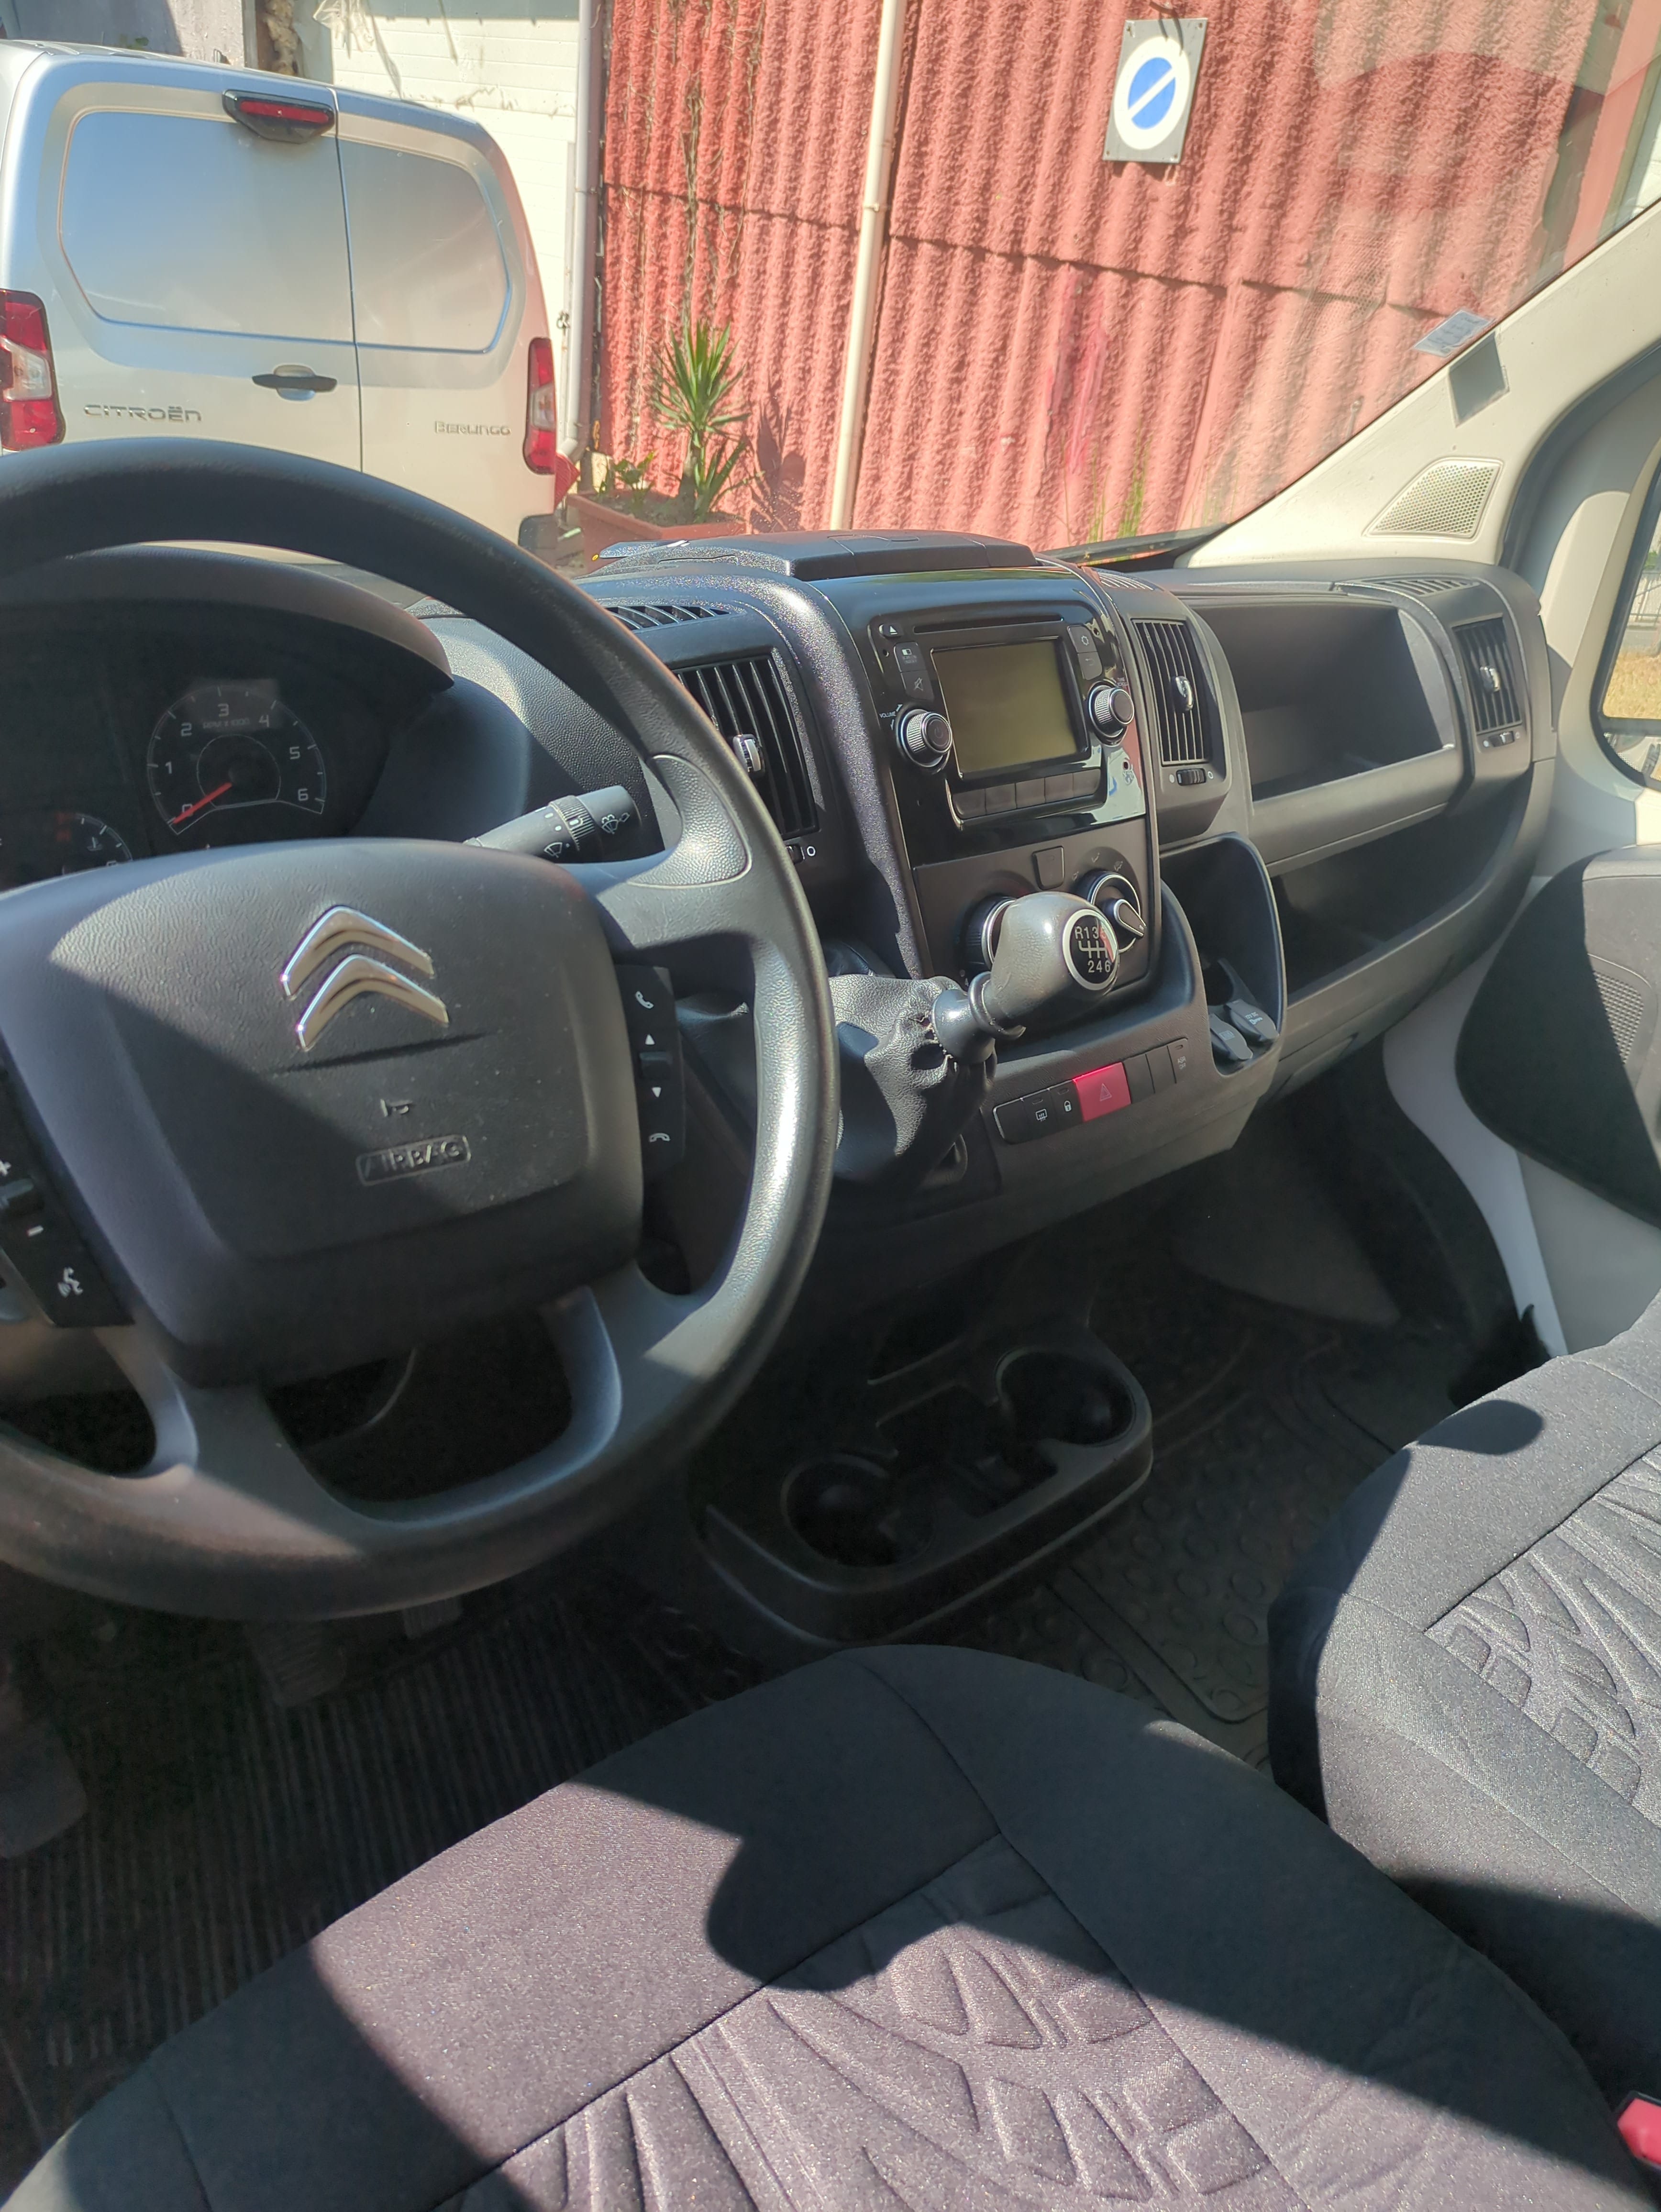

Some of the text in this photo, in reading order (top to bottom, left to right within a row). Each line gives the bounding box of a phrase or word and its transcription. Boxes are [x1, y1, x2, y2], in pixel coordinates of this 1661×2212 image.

[218, 703, 229, 717] 3
[259, 714, 270, 728] 4
[181, 722, 192, 737] 2
[289, 746, 300, 760] 5
[165, 762, 173, 774] 1
[298, 788, 309, 801] 6
